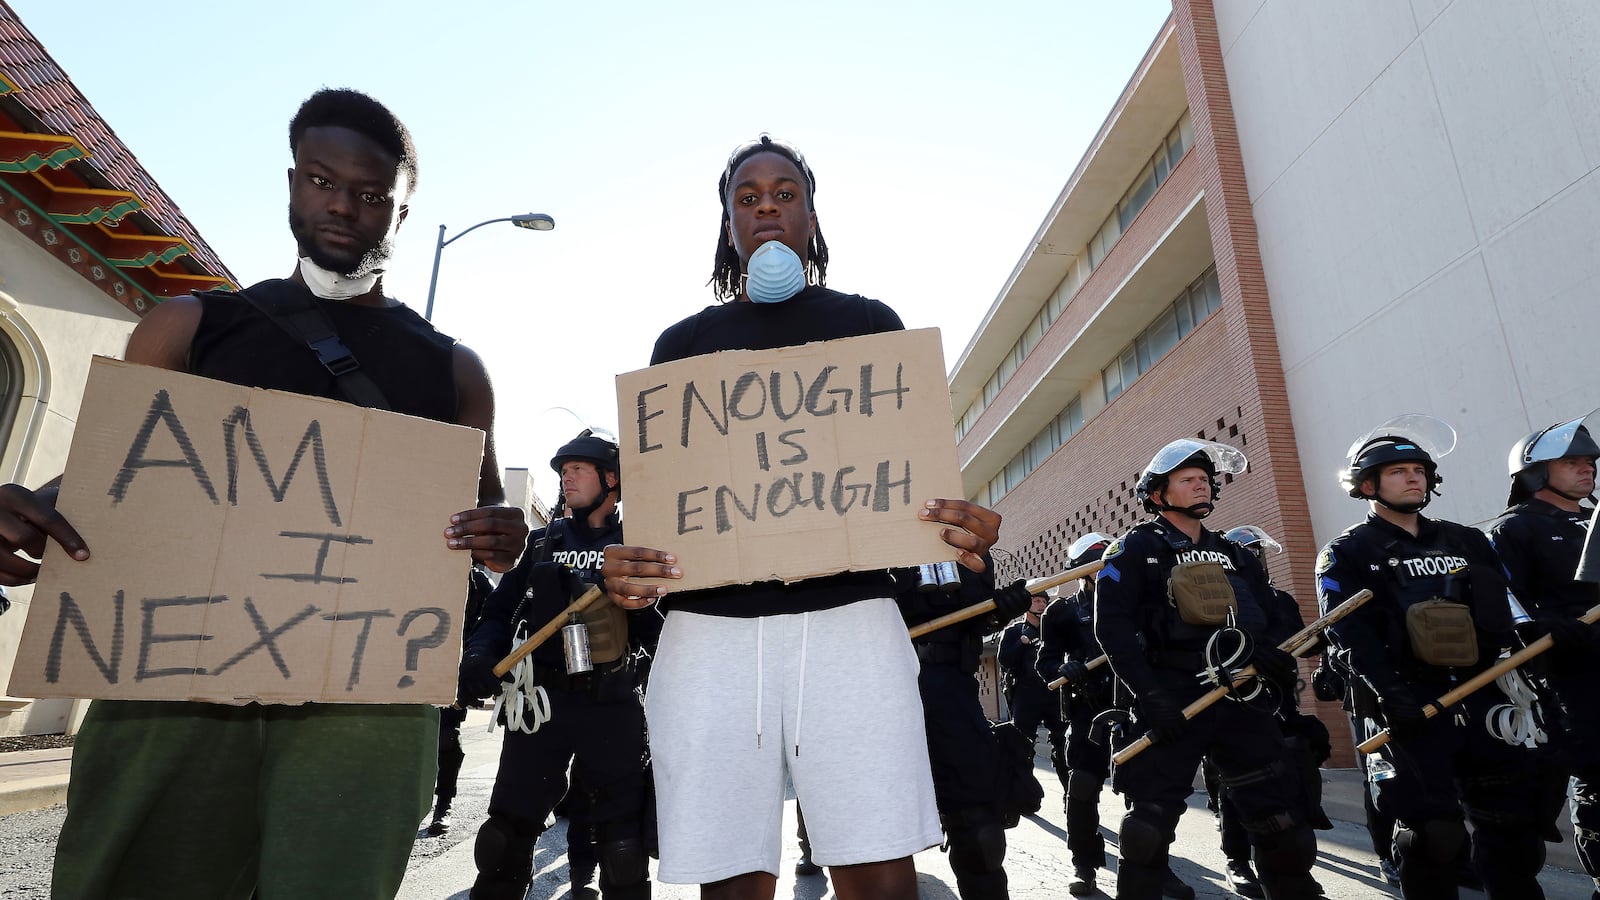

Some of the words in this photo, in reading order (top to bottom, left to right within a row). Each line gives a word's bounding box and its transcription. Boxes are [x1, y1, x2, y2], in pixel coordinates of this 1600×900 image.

[637, 362, 910, 453] ENOUGH
[107, 389, 342, 527] AM
[756, 428, 808, 471] IS
[677, 460, 911, 535] ENOUGH
[260, 531, 373, 584] I
[552, 550, 605, 570] TROOPE
[45, 590, 451, 691] NEXT?
